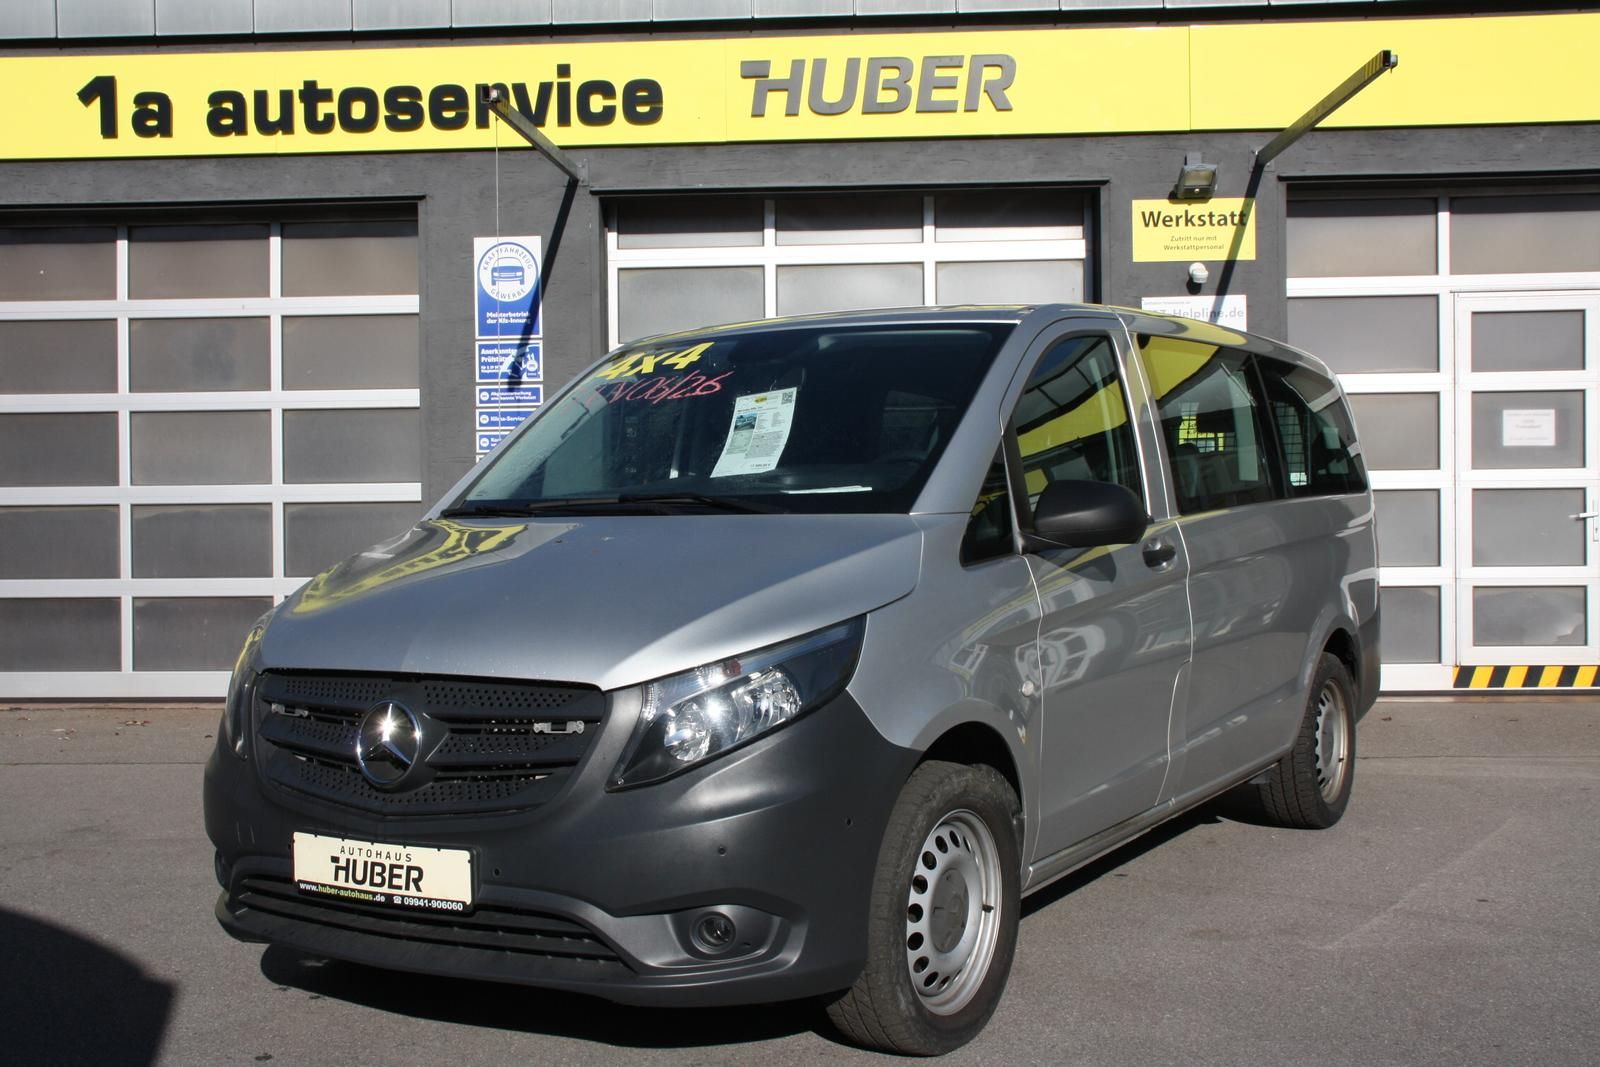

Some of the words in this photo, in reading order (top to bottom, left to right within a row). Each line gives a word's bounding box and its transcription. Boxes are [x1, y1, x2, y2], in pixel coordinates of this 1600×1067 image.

[740, 53, 1017, 118] HUBER
[76, 75, 174, 140] 1a
[206, 63, 664, 138] autoservice
[1141, 209, 1247, 228] Werkstatt
[483, 247, 534, 270] KRAFTFAHRZEUG
[1163, 243, 1225, 251] Werkstattpersonal
[490, 288, 526, 300] GEWERBE
[339, 845, 413, 862] AUTOHAUS
[330, 855, 424, 892] HUBER
[299, 882, 386, 903] www.huber-autohaus.de
[403, 896, 464, 911] 09941-906060
